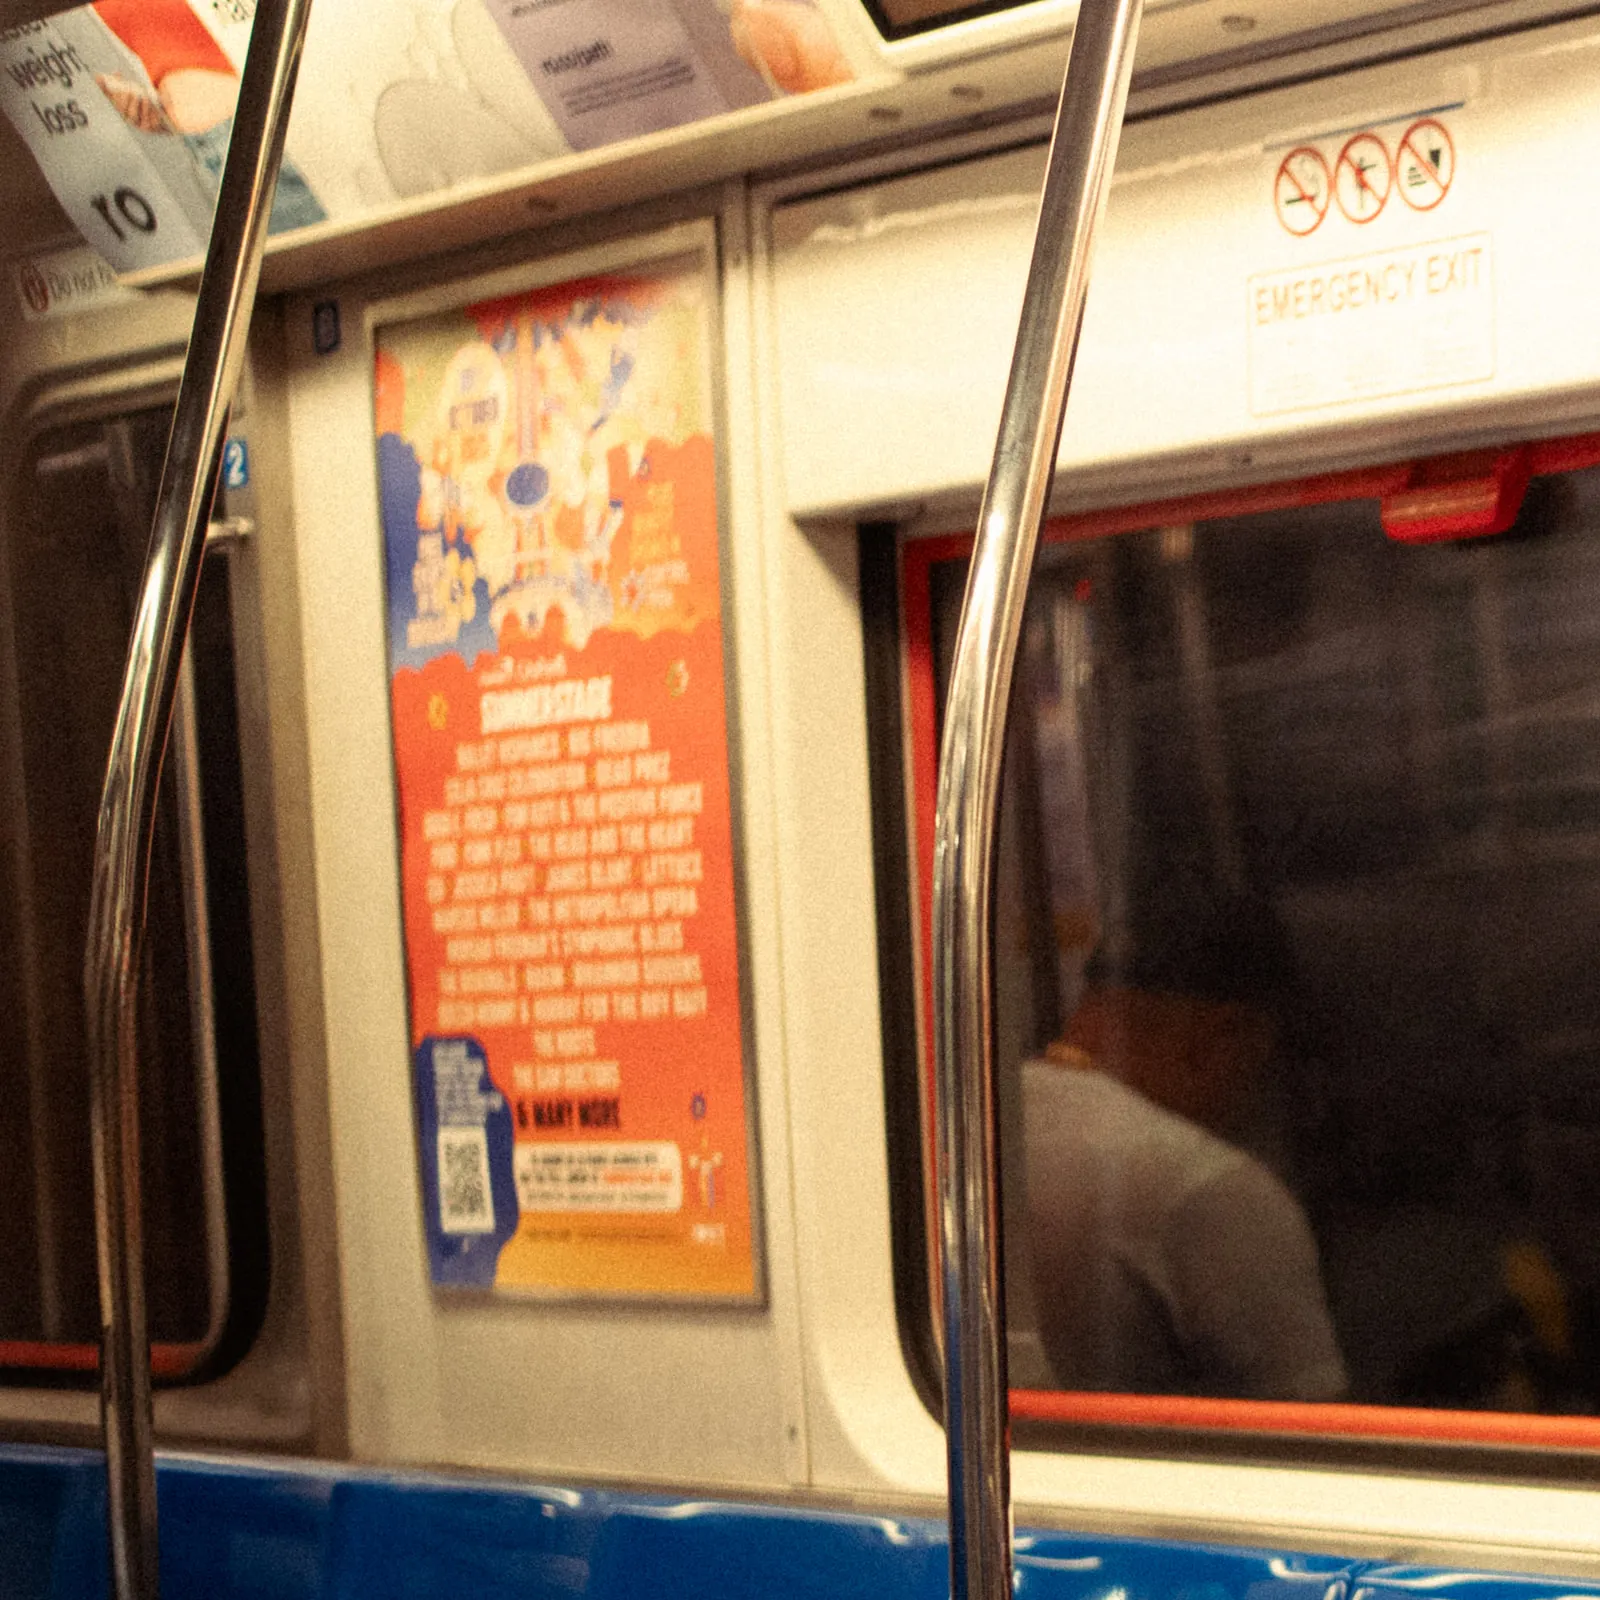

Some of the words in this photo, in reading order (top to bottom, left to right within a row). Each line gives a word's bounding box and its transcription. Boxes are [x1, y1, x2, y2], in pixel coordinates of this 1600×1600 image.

[5, 40, 92, 89] weight
[31, 100, 89, 135] loss
[90, 186, 157, 242] ro
[1255, 261, 1418, 327] EMERGENCY
[1426, 247, 1483, 295] EXIT
[227, 441, 245, 487] 2
